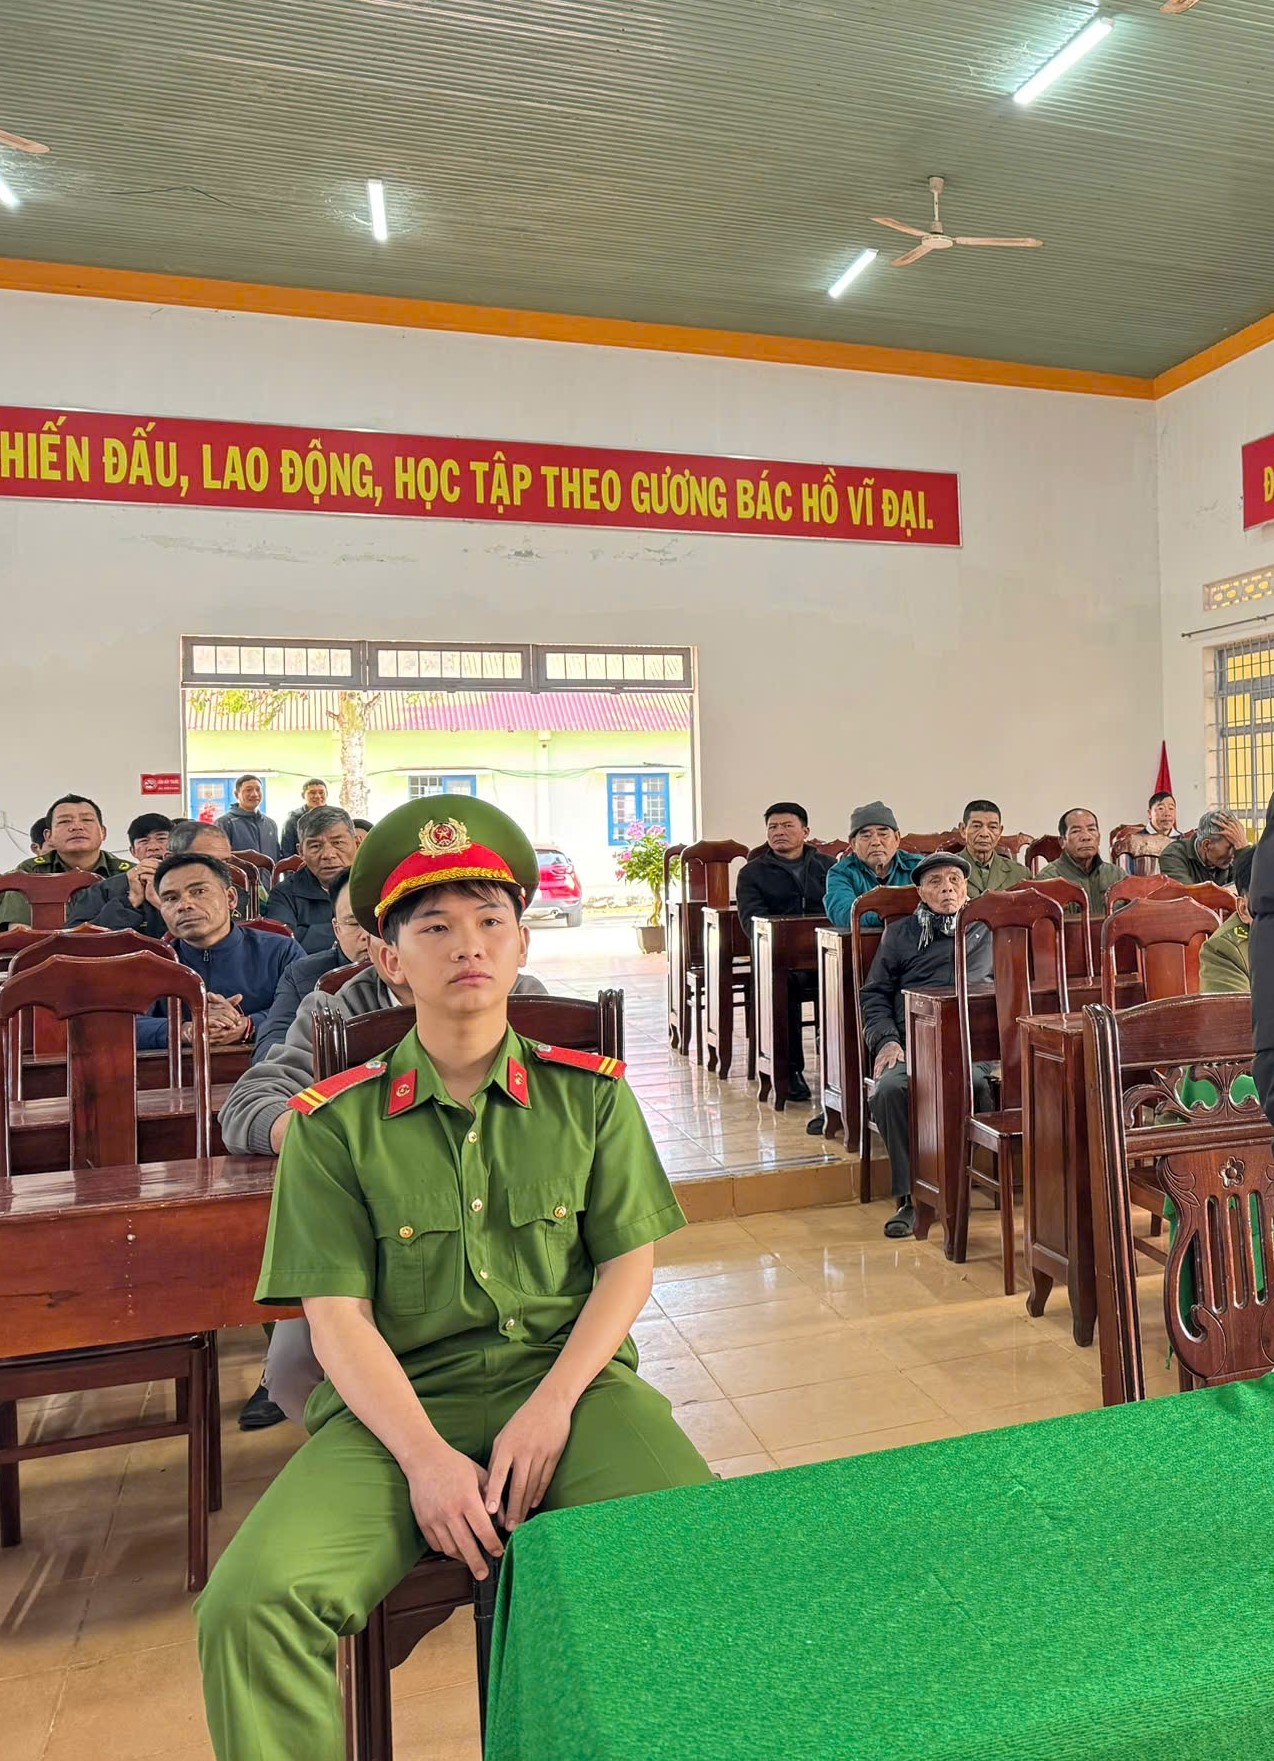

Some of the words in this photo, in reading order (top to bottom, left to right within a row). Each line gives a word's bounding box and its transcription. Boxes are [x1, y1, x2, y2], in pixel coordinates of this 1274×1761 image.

[102, 422, 190, 497] ĐẤU,
[202, 444, 270, 494] LAO
[280, 439, 383, 507] ĐỘNG,
[395, 458, 461, 510] HỌC
[469, 451, 532, 514] TẬP
[540, 465, 622, 513] THEO
[631, 465, 729, 519] GƯƠNG
[736, 470, 793, 523] BÁC
[802, 467, 840, 525] HỒ
[848, 477, 875, 527] VĨ
[881, 489, 935, 537] ĐẠI.
